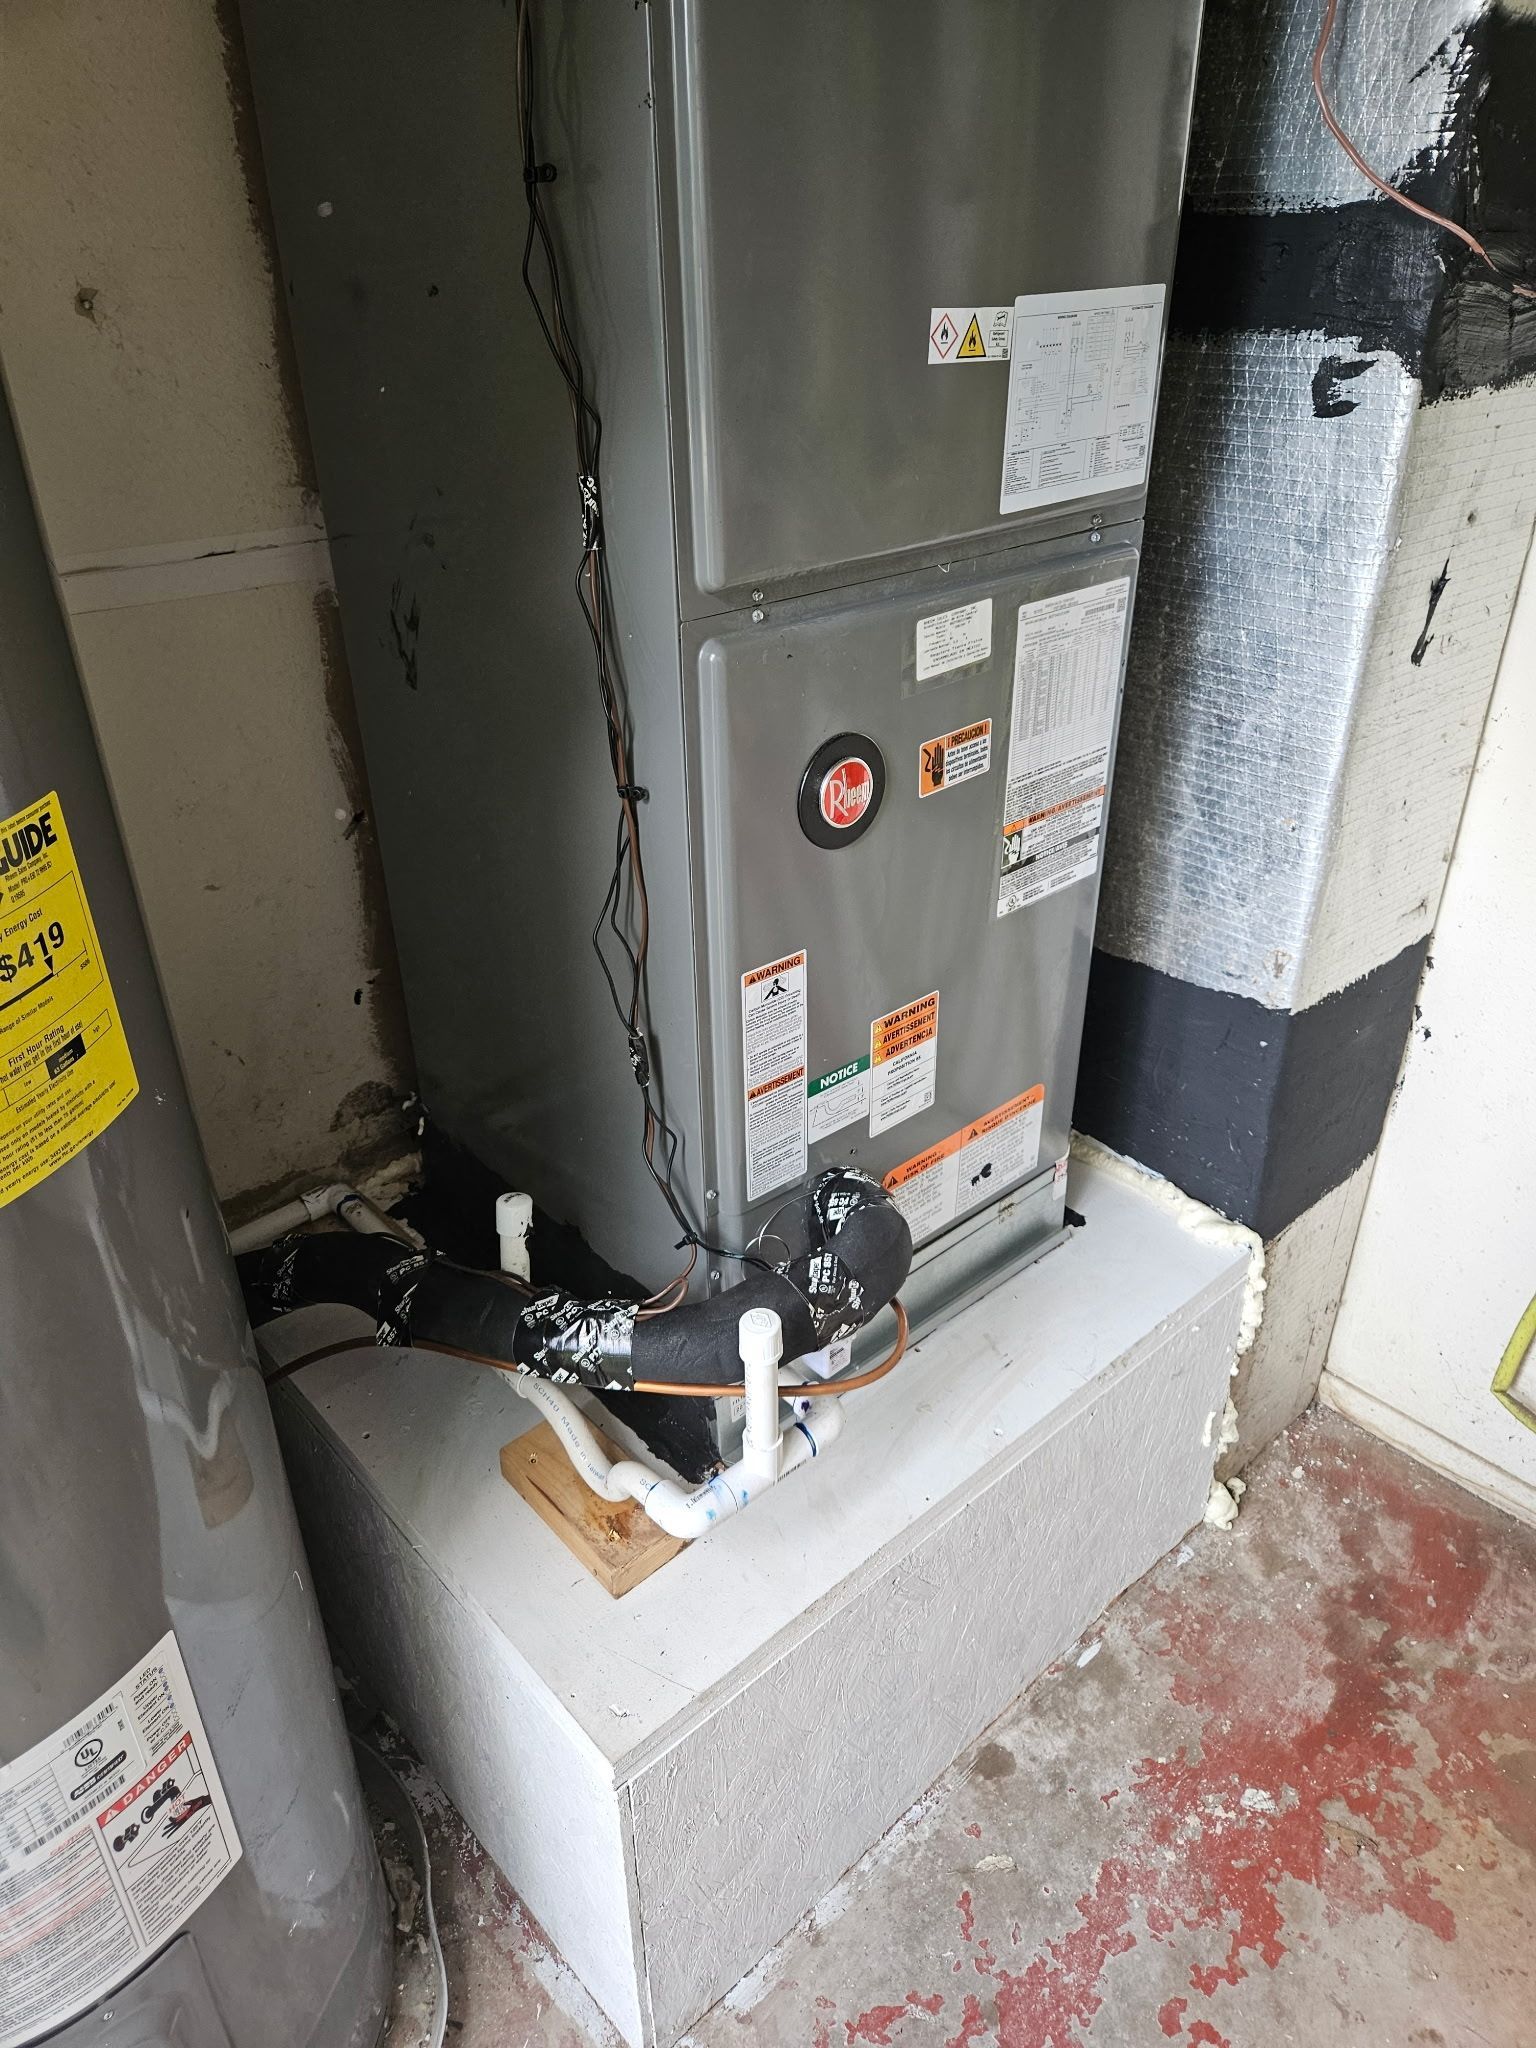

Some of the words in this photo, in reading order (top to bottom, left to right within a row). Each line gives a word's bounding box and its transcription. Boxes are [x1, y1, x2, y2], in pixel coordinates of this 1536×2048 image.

[829, 768, 872, 819] Rheem
[4, 917, 28, 937] Energy
[28, 908, 43, 922] Cost
[0, 921, 64, 983] $419
[756, 956, 801, 981] WARNING
[884, 997, 936, 1028] WARNING
[883, 1011, 935, 1045] AVERTISSEMENT
[886, 1026, 933, 1058] ADVERTENCIA
[8, 1051, 25, 1067] First
[26, 1040, 43, 1056] Hour
[44, 1025, 65, 1043] Rating
[756, 1068, 804, 1096] AVERTISSEMENT
[820, 1062, 858, 1089] NOTICE
[903, 1169, 918, 1181] RISK
[920, 1163, 928, 1171] OF
[930, 1153, 945, 1165] FIRE
[906, 1151, 937, 1172] WARNING
[822, 1268, 831, 1283] PC
[561, 1416, 580, 1448] Made
[135, 1666, 158, 1690] STATUS
[80, 1747, 98, 1760] UL
[123, 1740, 187, 1806] DANGER
